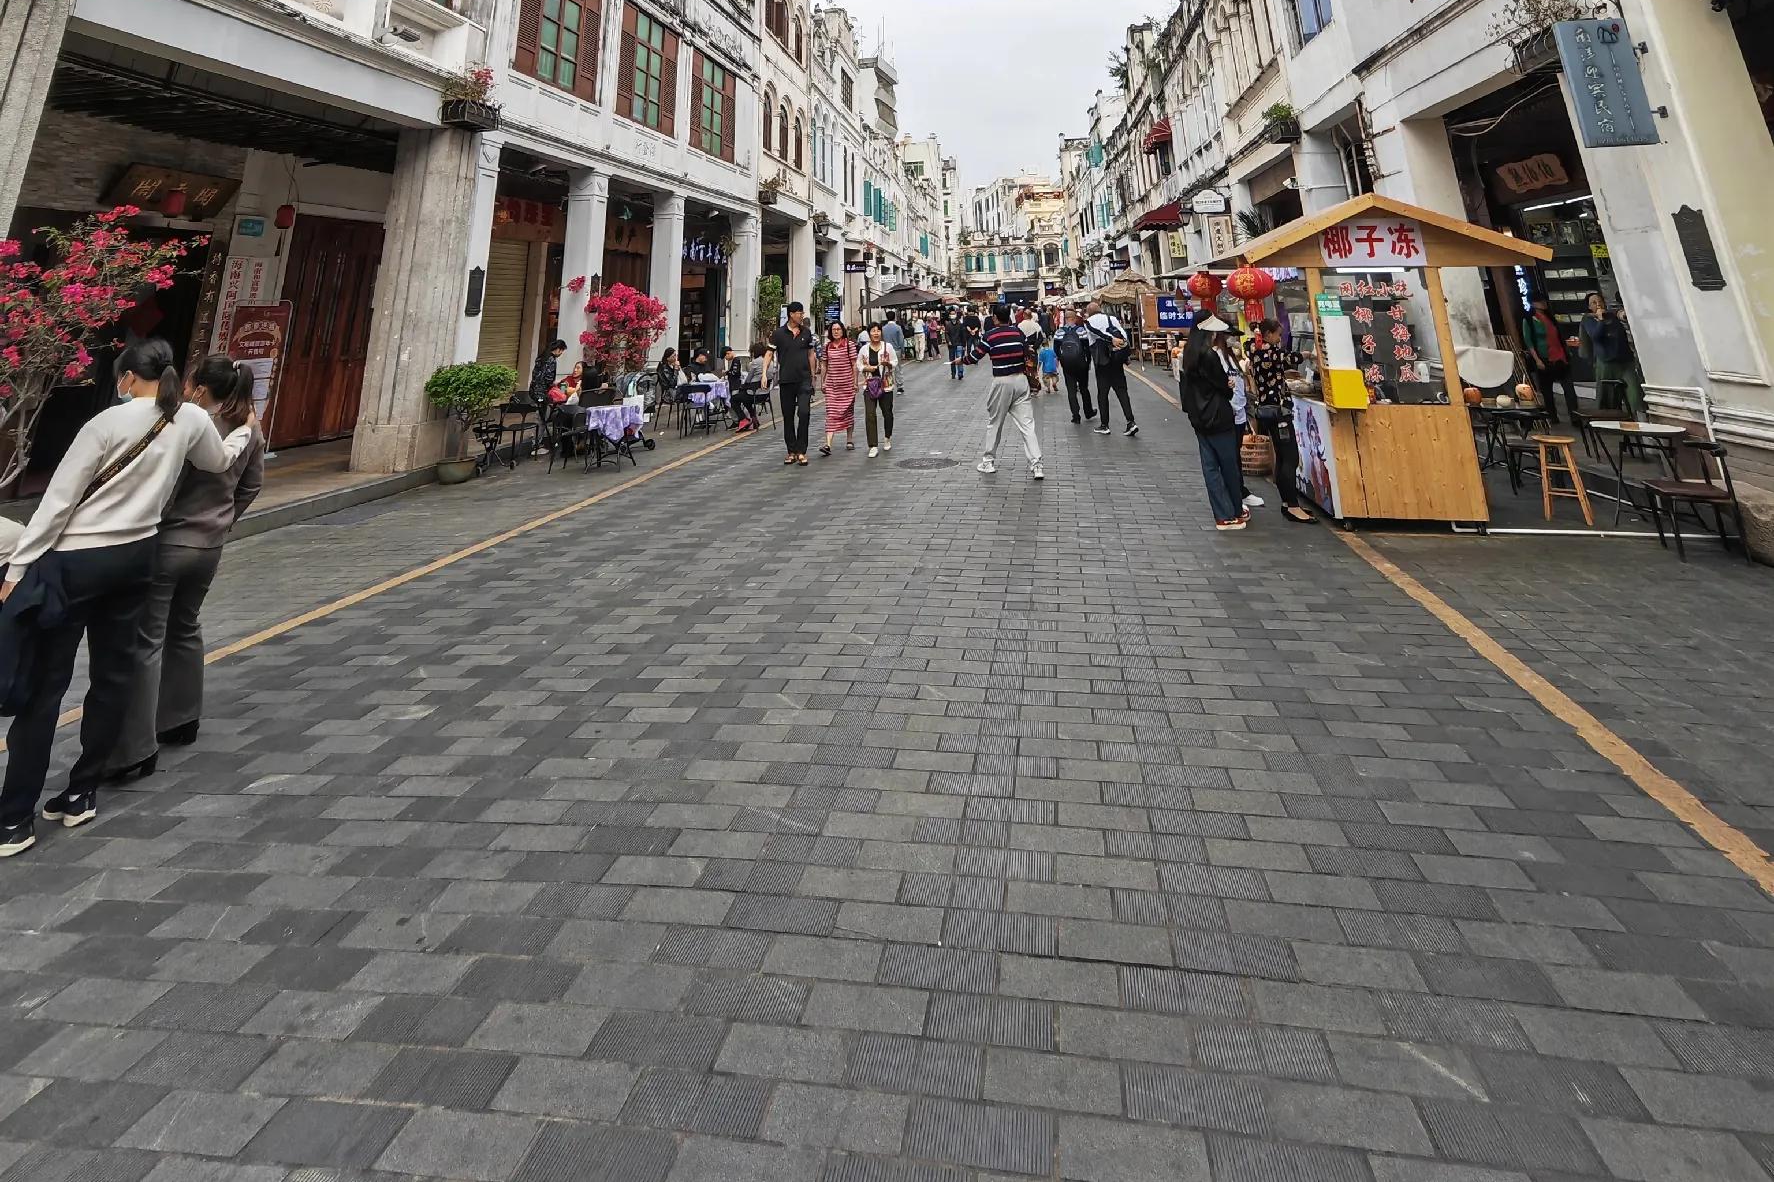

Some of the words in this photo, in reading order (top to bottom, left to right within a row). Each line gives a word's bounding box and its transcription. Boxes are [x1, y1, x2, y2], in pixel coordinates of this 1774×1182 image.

[1323, 222, 1420, 260] 椰子冻
[1338, 279, 1414, 299] 网红小吃
[1352, 305, 1385, 383] 椰子冻
[1386, 304, 1422, 383] 甘梅地瓜
